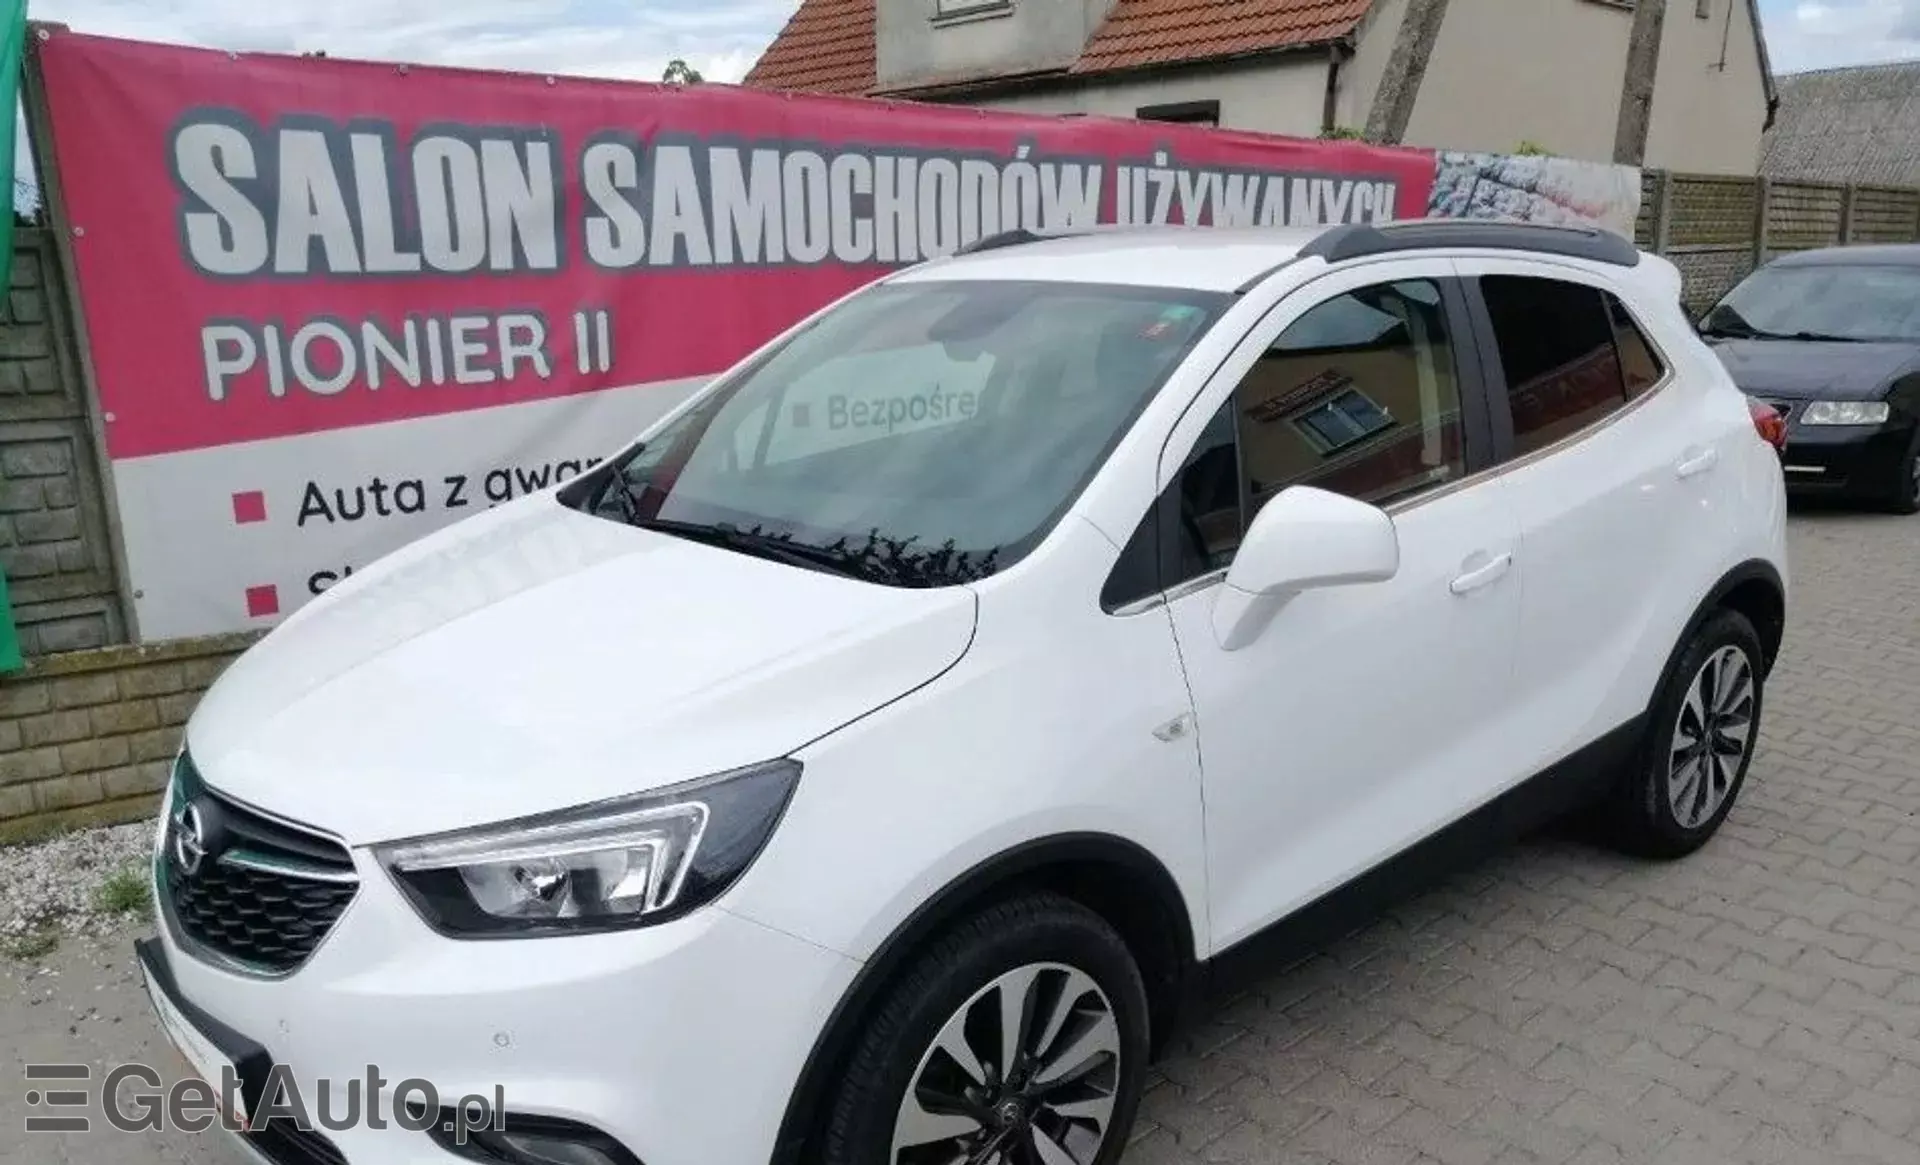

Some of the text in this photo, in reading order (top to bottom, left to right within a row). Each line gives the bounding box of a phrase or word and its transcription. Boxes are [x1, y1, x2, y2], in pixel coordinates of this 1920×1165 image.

[174, 123, 1396, 275] SALON SAMOCHODÓW UŻYWANYCH
[201, 310, 610, 400] PIONIER II
[297, 477, 427, 527] Auta
[444, 475, 470, 508] z
